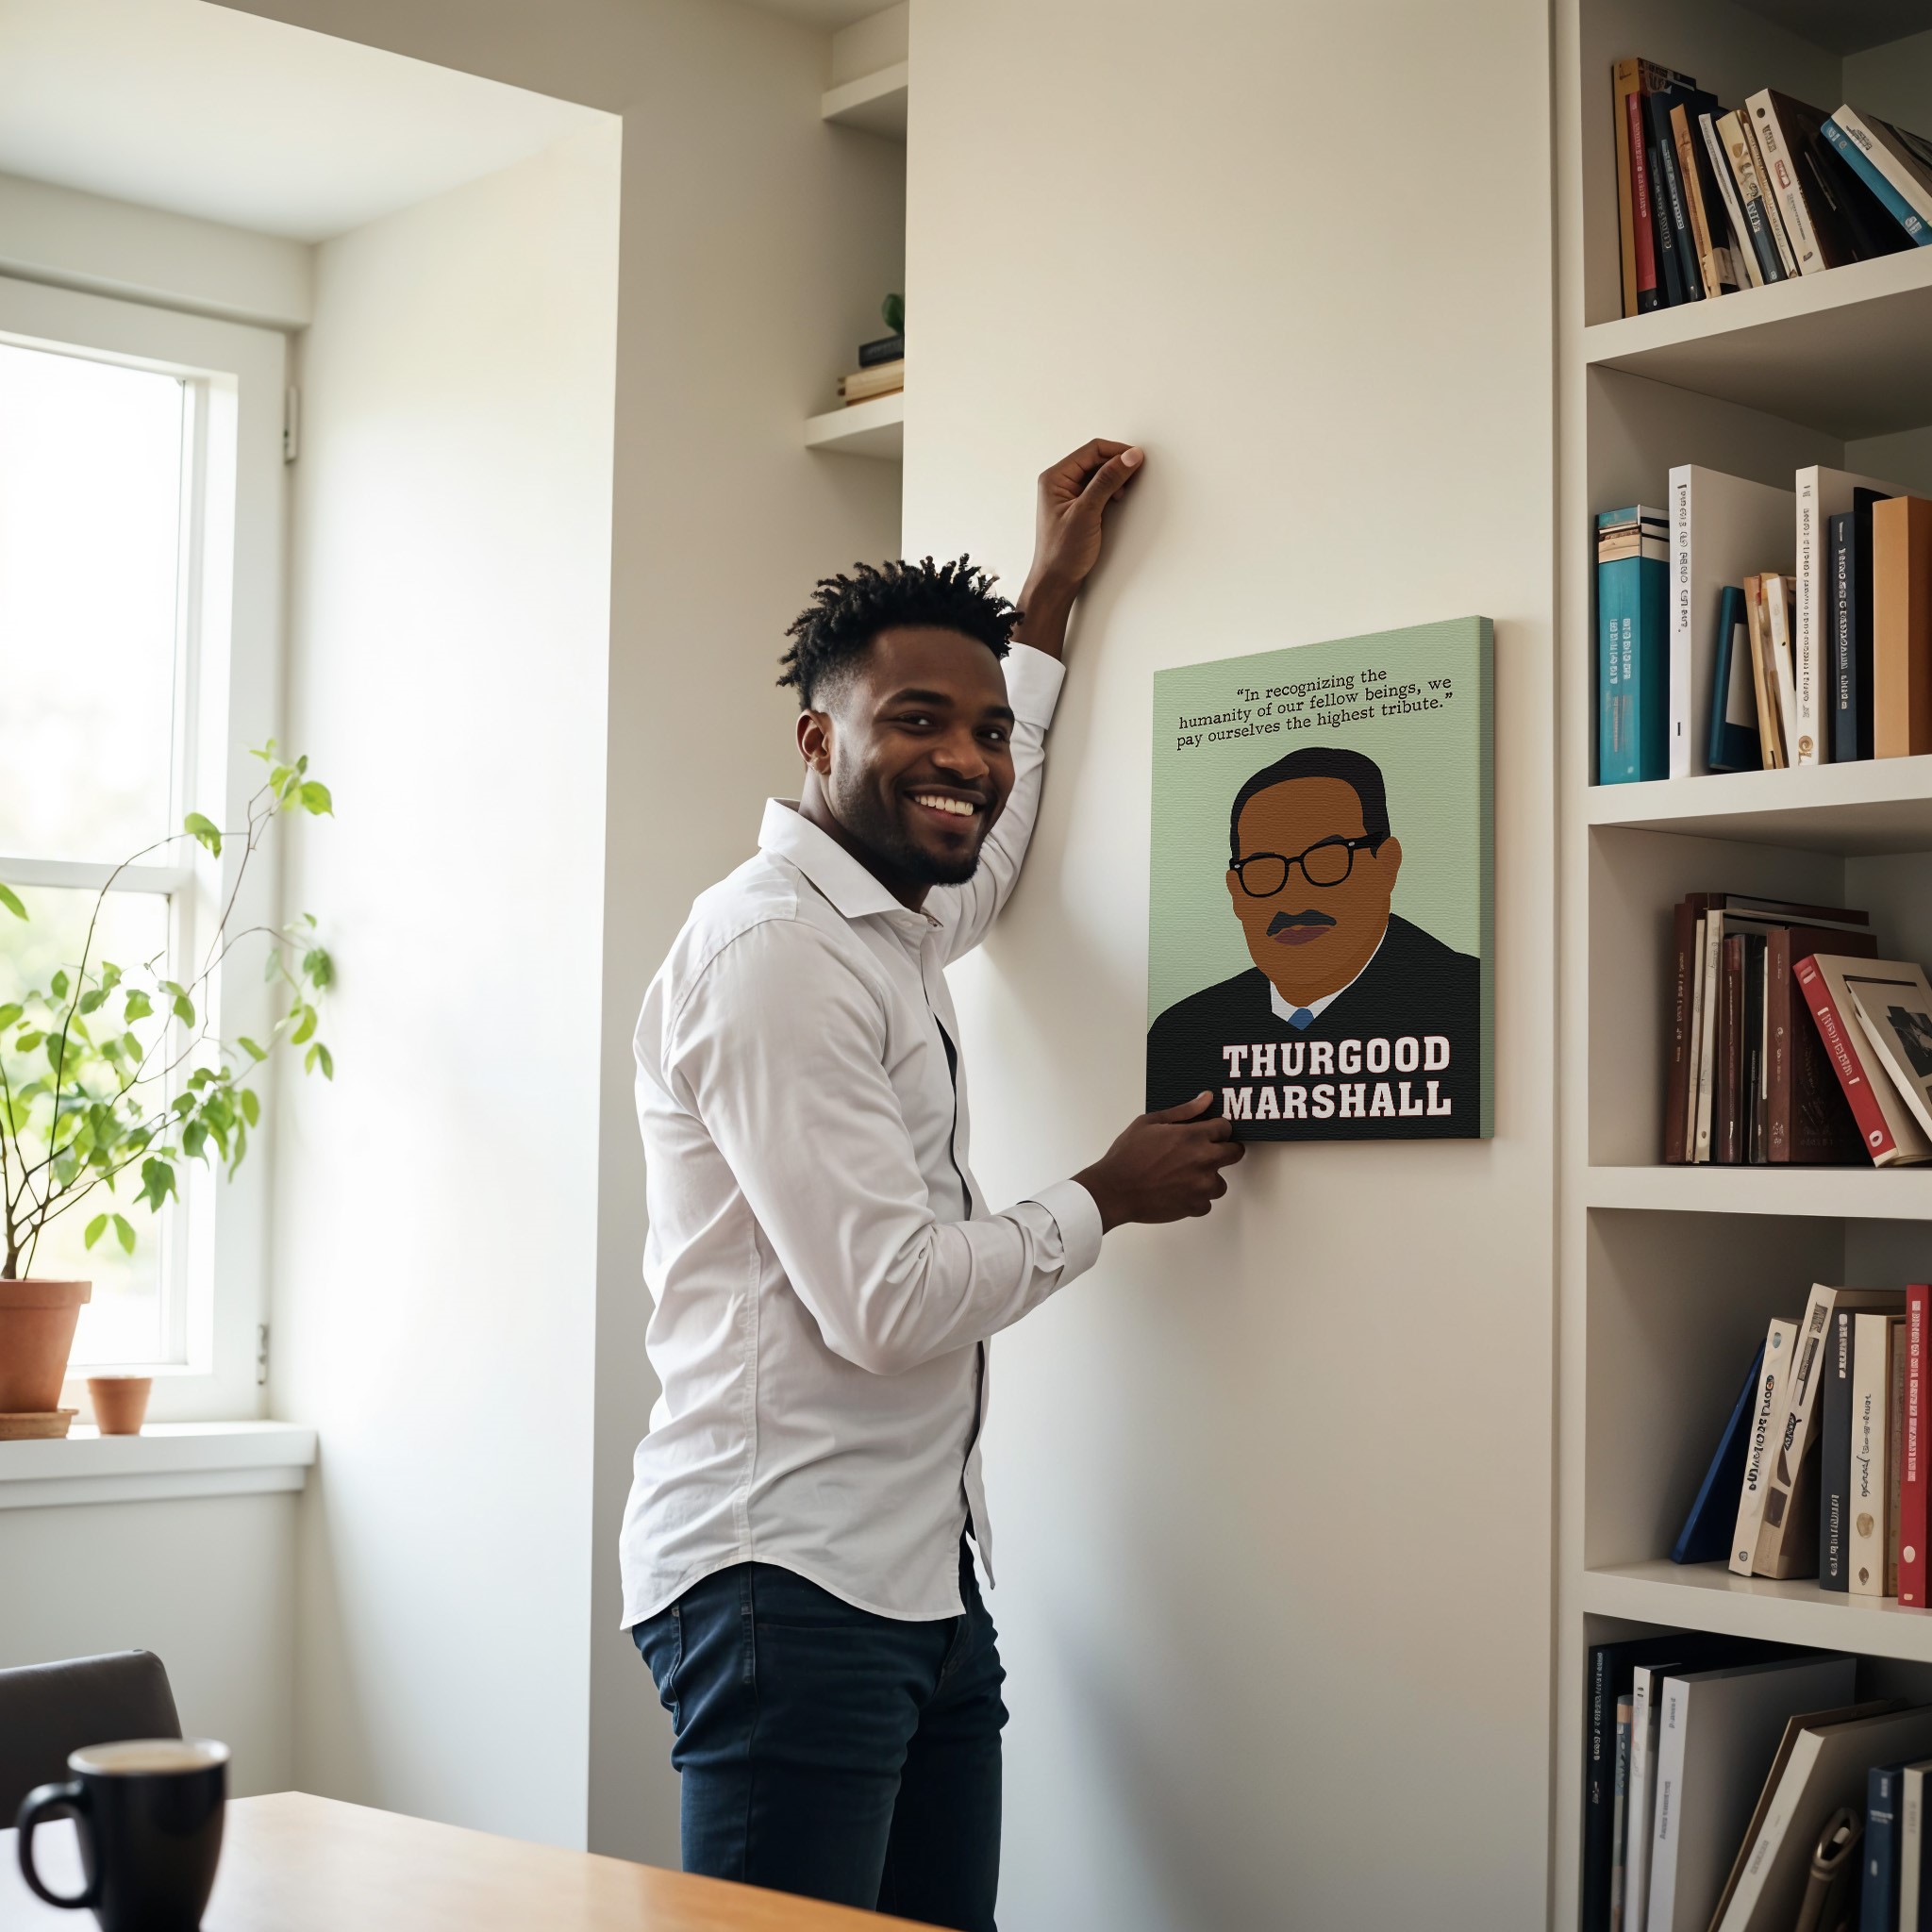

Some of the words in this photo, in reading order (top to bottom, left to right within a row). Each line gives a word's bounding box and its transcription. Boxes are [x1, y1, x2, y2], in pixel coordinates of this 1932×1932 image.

[1179, 708, 1252, 729] humanity
[1257, 702, 1273, 718] of
[1277, 701, 1305, 714] our
[1309, 692, 1358, 709] fellow
[1364, 683, 1422, 702] beings,
[1427, 678, 1452, 691] we
[1237, 688, 1260, 703] “In
[1265, 675, 1355, 699] recognizing
[1360, 669, 1387, 684] the
[1176, 734, 1203, 751] pay
[1208, 722, 1281, 742] ourselves
[1286, 716, 1311, 731] the
[1317, 706, 1375, 728] highest
[1381, 691, 1454, 717] tribute.”
[1223, 1036, 1450, 1077] THURGOOD
[1222, 1081, 1451, 1120] MARSHALL
